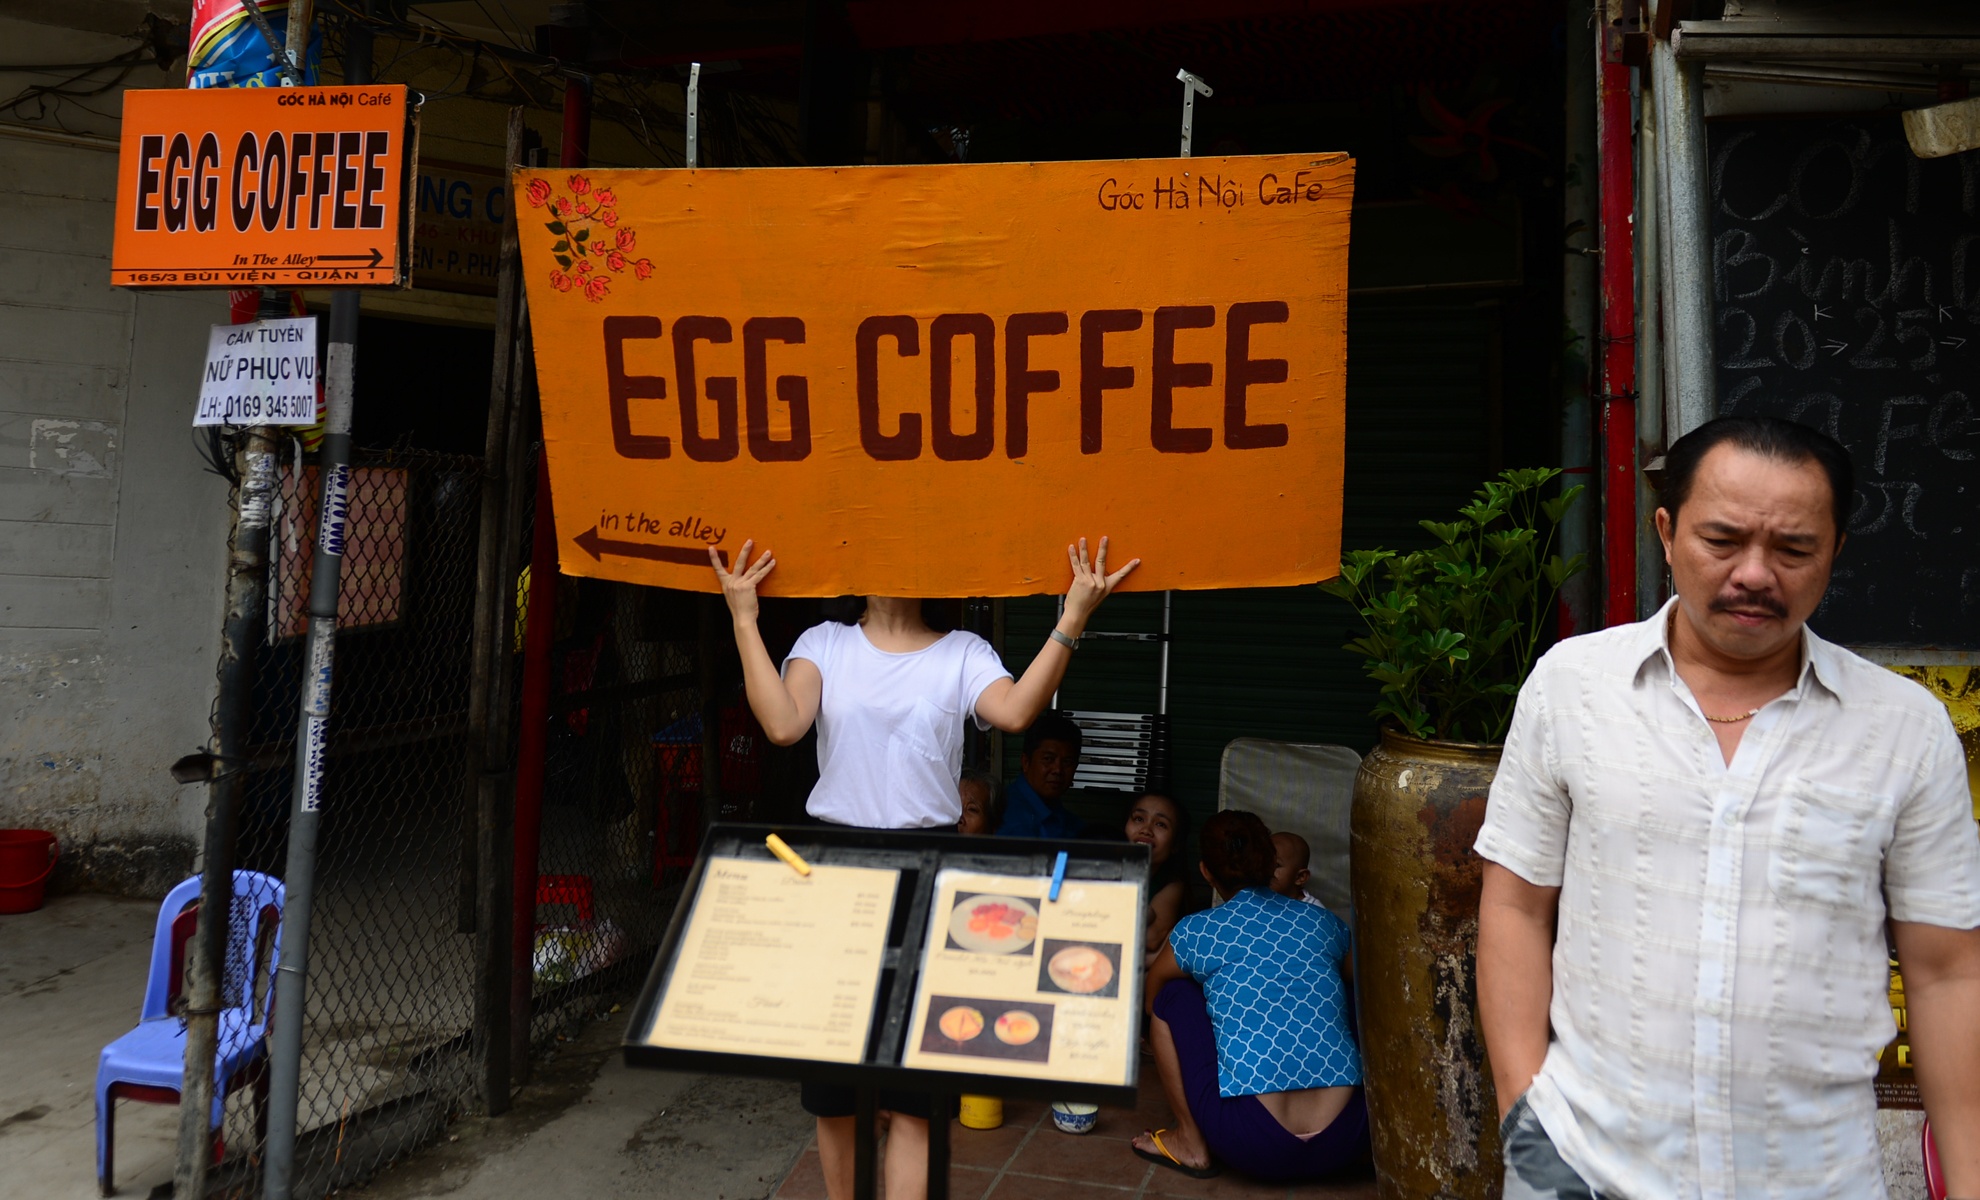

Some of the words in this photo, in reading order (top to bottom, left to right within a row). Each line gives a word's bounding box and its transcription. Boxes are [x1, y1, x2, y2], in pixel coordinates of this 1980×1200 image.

[277, 93, 304, 106] GÓC
[308, 93, 326, 106] HÀ
[330, 94, 353, 109] NỘI
[357, 92, 392, 106] Café
[134, 131, 220, 234] EGG
[231, 130, 390, 233] COFFEE
[417, 175, 473, 220] NG
[1098, 178, 1144, 211] Góc
[1154, 176, 1189, 210] Hà
[1199, 175, 1244, 214] Nội
[128, 273, 178, 282] 165/3
[184, 269, 219, 282] BÙI
[226, 268, 276, 282] VIỆN
[297, 268, 358, 282] QUẬN
[367, 271, 376, 280] 1
[233, 254, 249, 266] In
[250, 254, 278, 266] The
[282, 254, 316, 268] Alley
[236, 357, 291, 386] PHỤC
[295, 356, 314, 386] VỤ
[603, 315, 812, 463] EGG
[855, 301, 1289, 461] COFFEE
[200, 396, 221, 418] LH:
[226, 395, 261, 418] 0169
[266, 396, 288, 418] 345
[290, 396, 313, 418] 5007
[600, 508, 619, 531] in
[626, 512, 662, 536] the
[668, 517, 727, 546] alley
